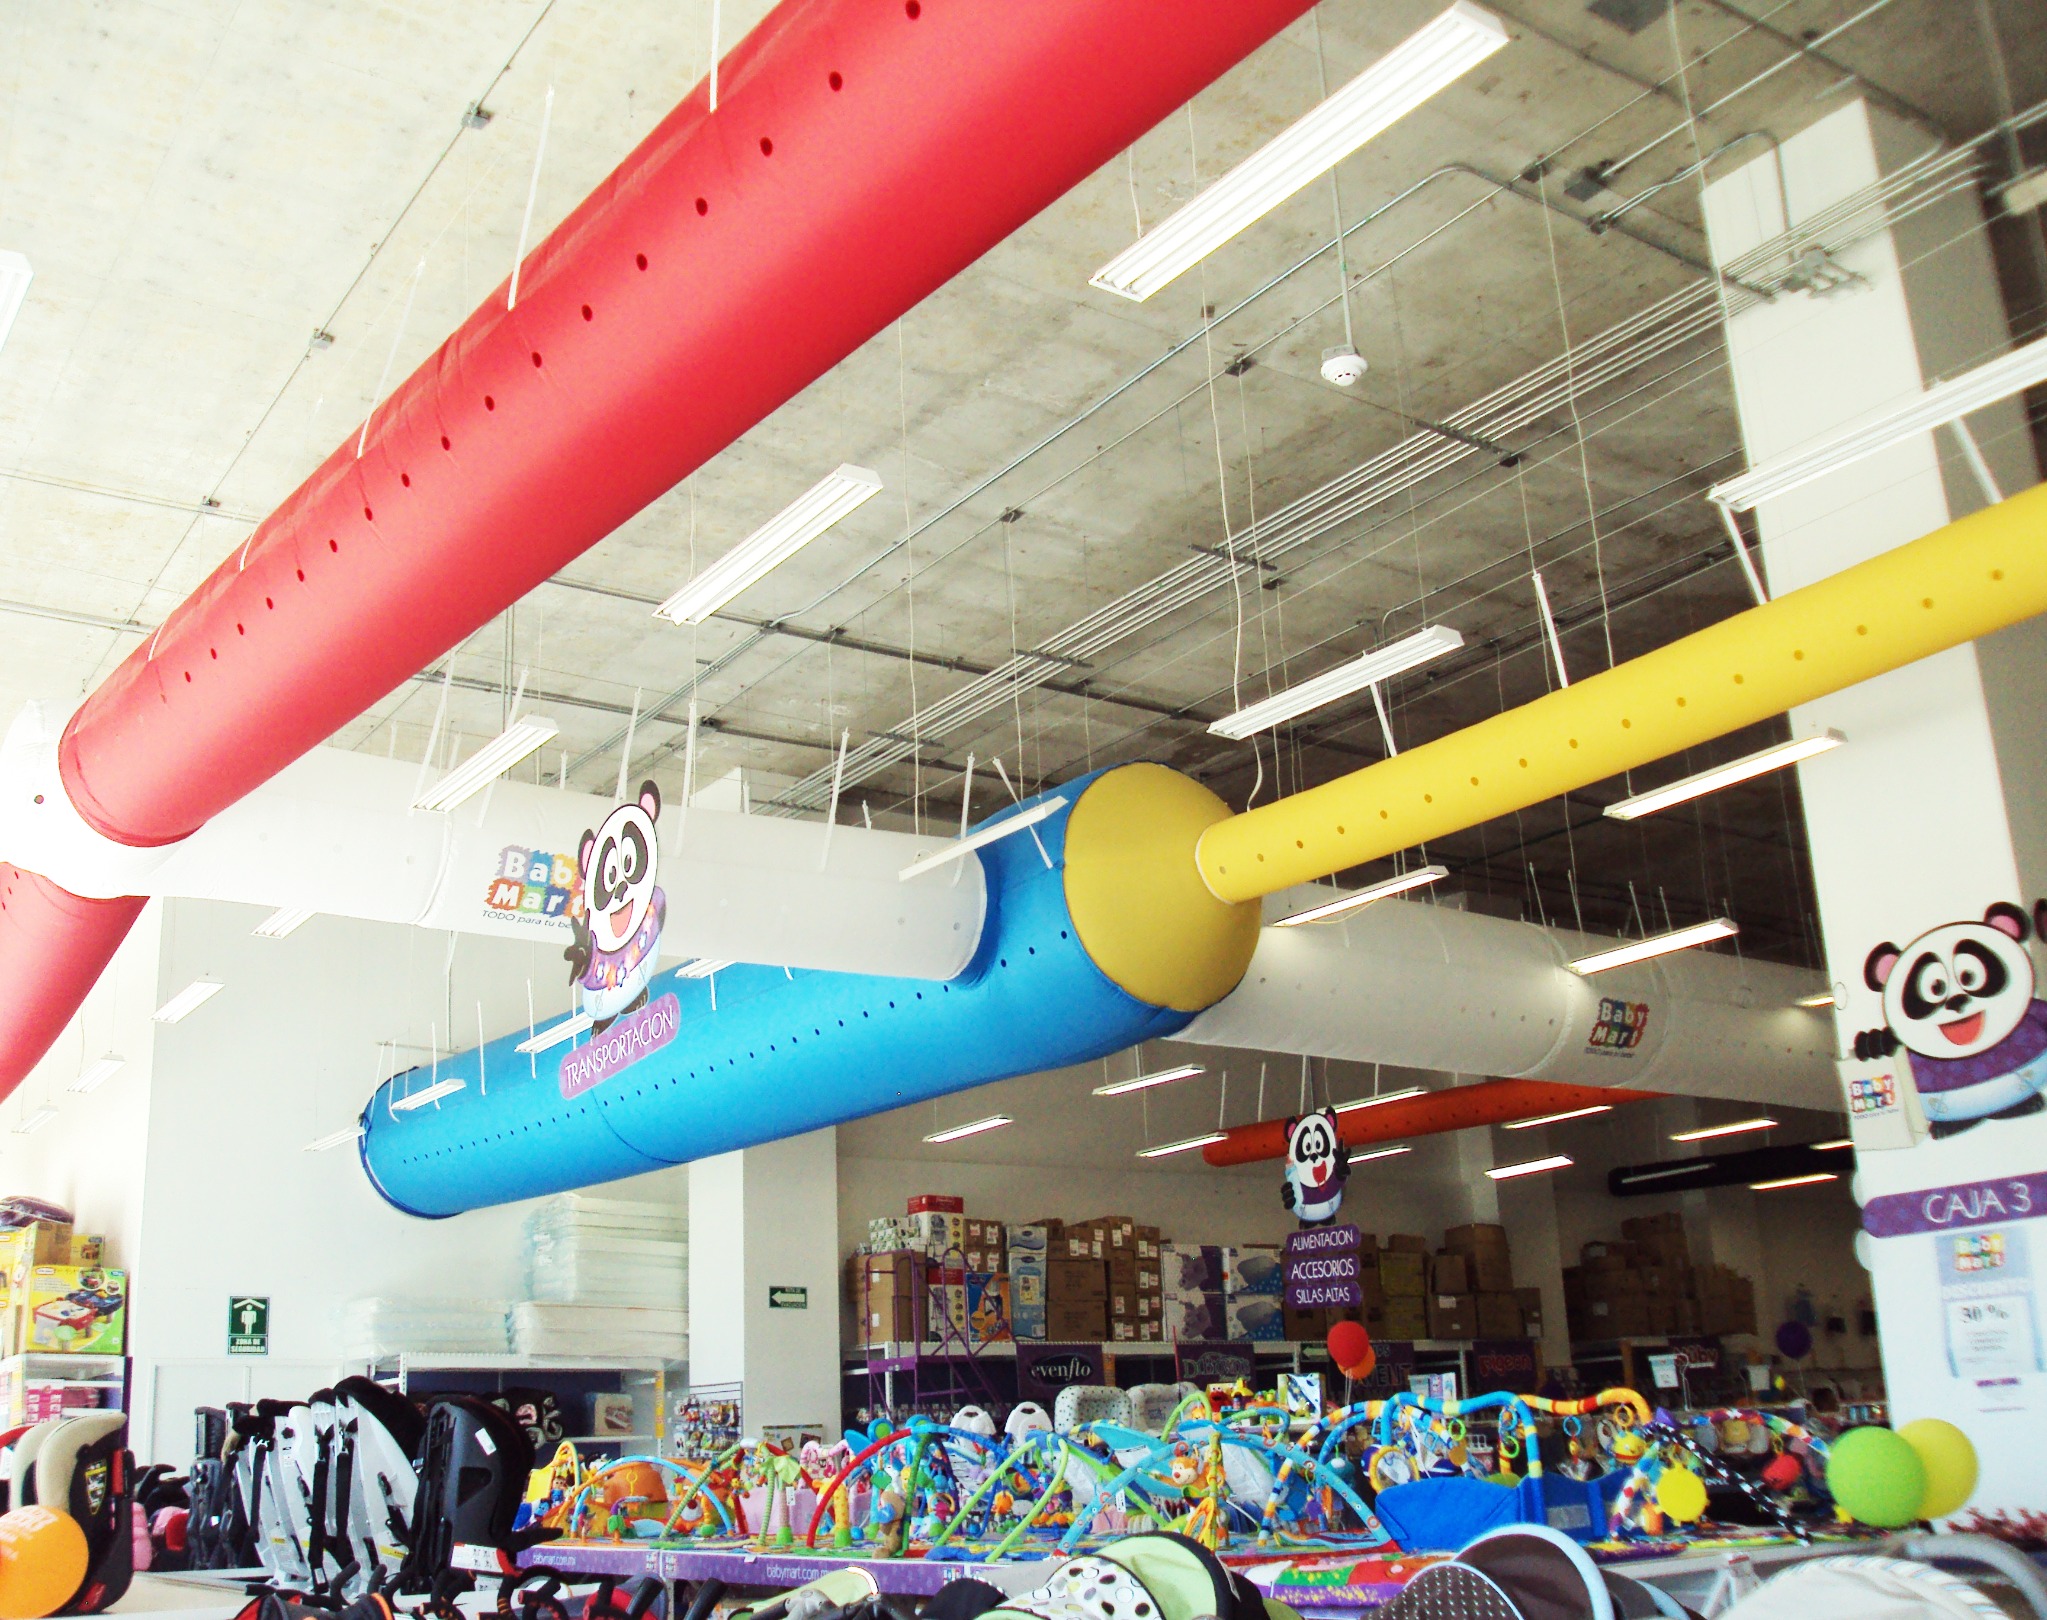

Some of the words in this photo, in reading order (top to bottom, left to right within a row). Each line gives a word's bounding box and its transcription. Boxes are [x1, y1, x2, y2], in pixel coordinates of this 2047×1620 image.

[502, 849, 585, 891] Bab
[482, 909, 516, 922] TODO
[517, 915, 542, 926] para
[544, 919, 556, 928] tu
[557, 920, 573, 930] be
[1600, 1001, 1647, 1028] Baby
[564, 1004, 675, 1089] TRANSPORTACION
[1591, 1025, 1639, 1047] Mart
[1851, 1078, 1893, 1097] Baby
[1852, 1092, 1894, 1111] Mart
[1922, 1188, 2007, 1224] CAJA
[2008, 1181, 2031, 1213] 3
[1291, 1229, 1354, 1252] ALIMENTACION
[1291, 1258, 1355, 1280] ACCESORIOS
[1295, 1288, 1324, 1304] SILLAS
[1325, 1286, 1350, 1302] ALTAS
[230, 1345, 266, 1353] SEGURIDAD
[252, 1338, 261, 1346] DE
[1030, 1356, 1092, 1382] evenflo
[766, 1563, 829, 1582] babymart.com.m
